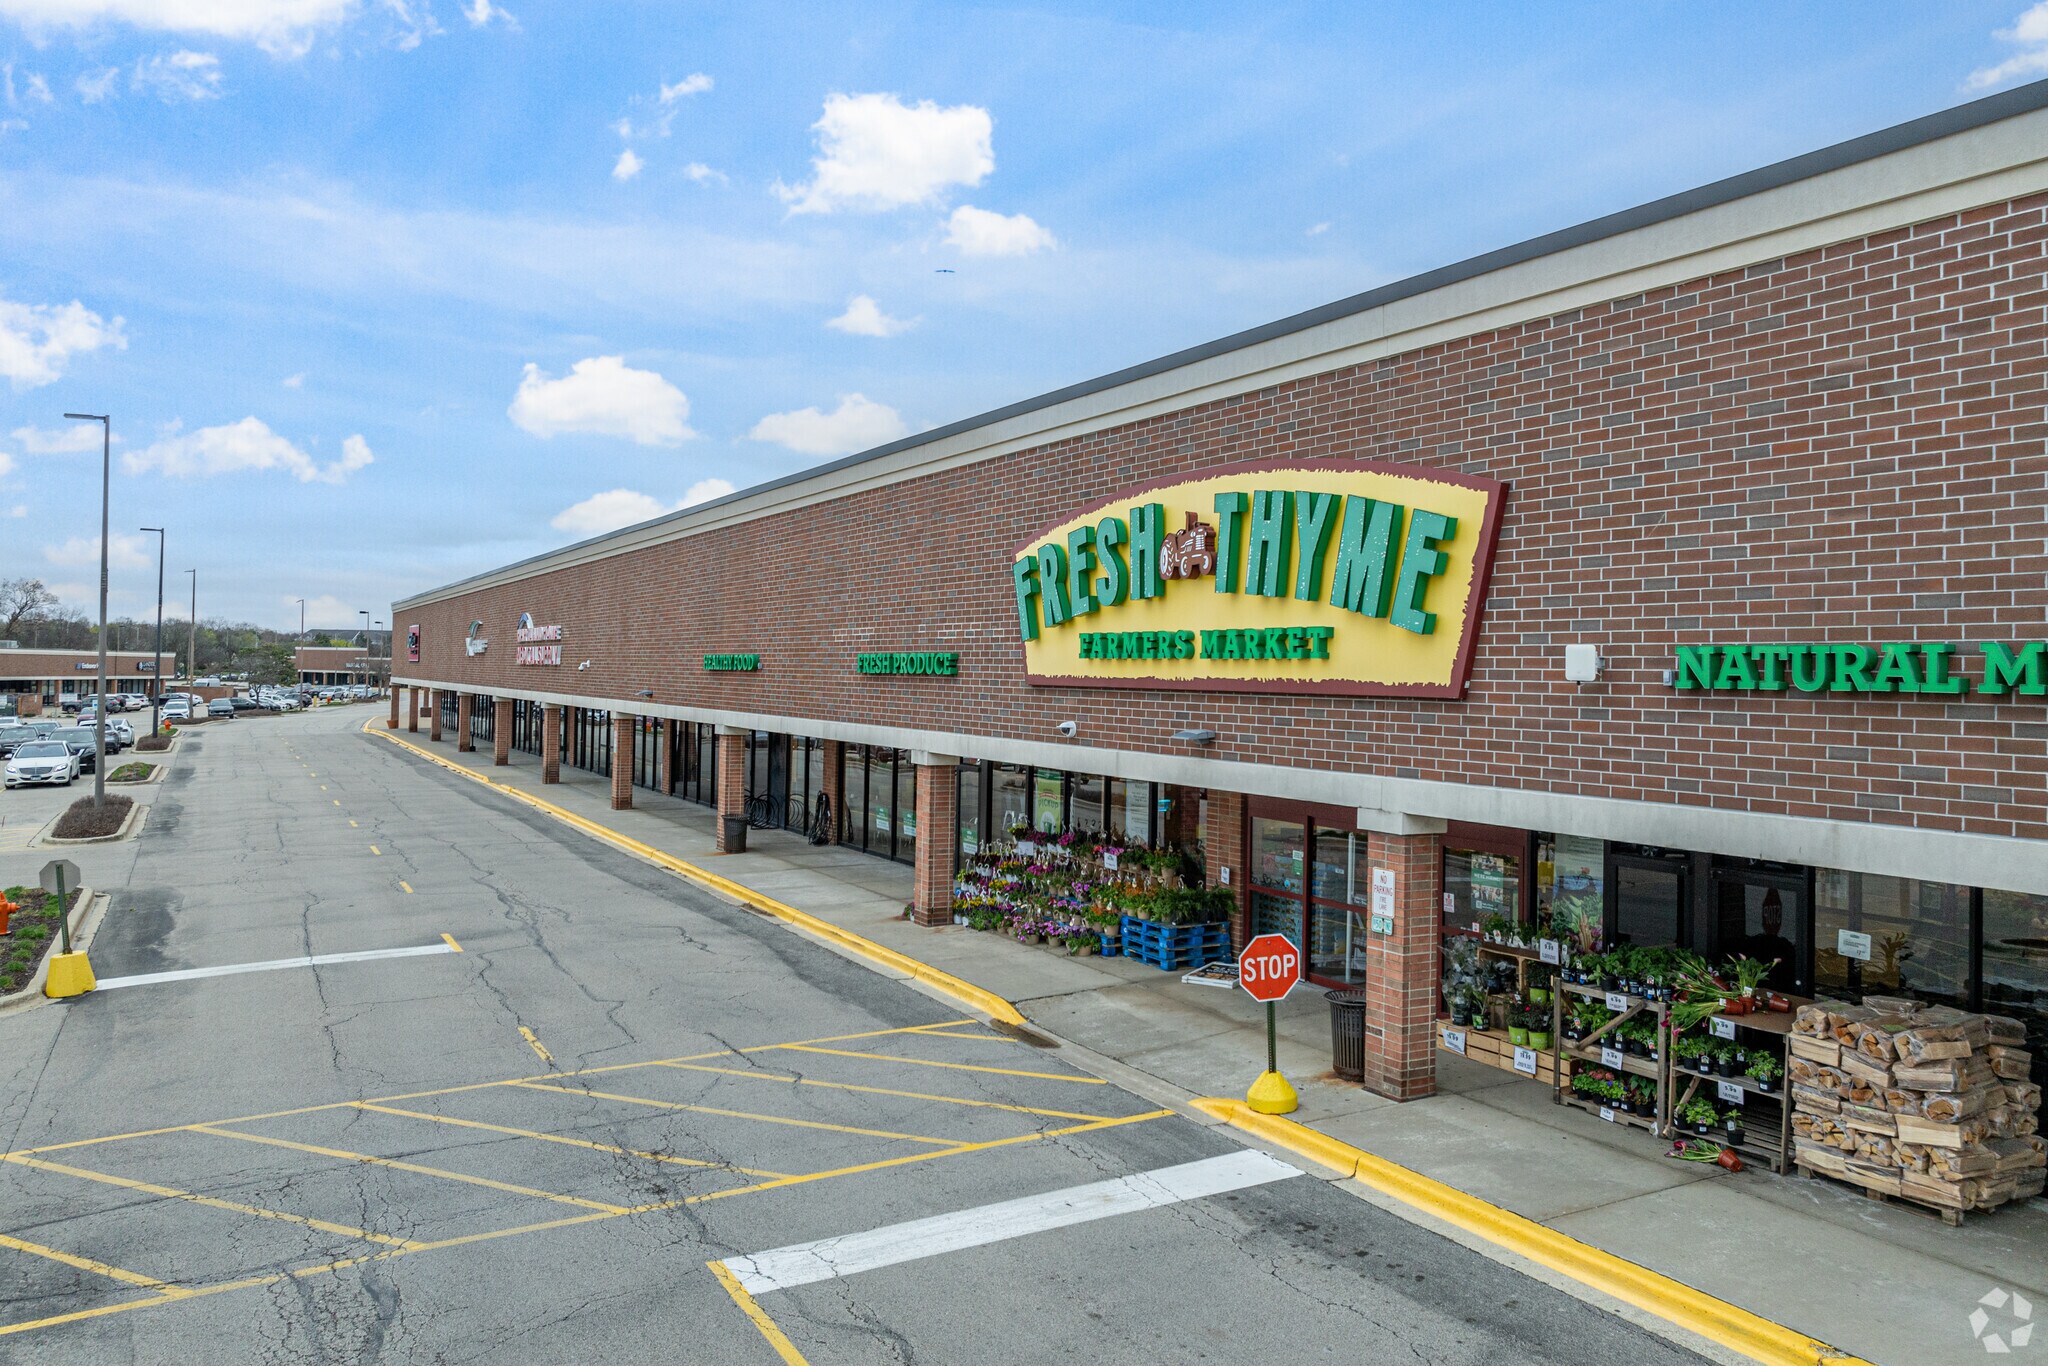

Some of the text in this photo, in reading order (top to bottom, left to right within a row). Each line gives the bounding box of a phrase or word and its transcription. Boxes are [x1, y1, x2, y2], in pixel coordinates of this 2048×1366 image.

[1013, 490, 1458, 642] FRESH THYME
[1079, 626, 1334, 660] FARMERS MARKET
[703, 654, 759, 671] HEALTHY FOOD
[857, 653, 958, 676] FRESH PRODUCE
[1675, 643, 1970, 694] NATURAL
[1374, 884, 1394, 897] PARKING
[1380, 875, 1388, 884] NO
[1244, 953, 1296, 982] STOP
